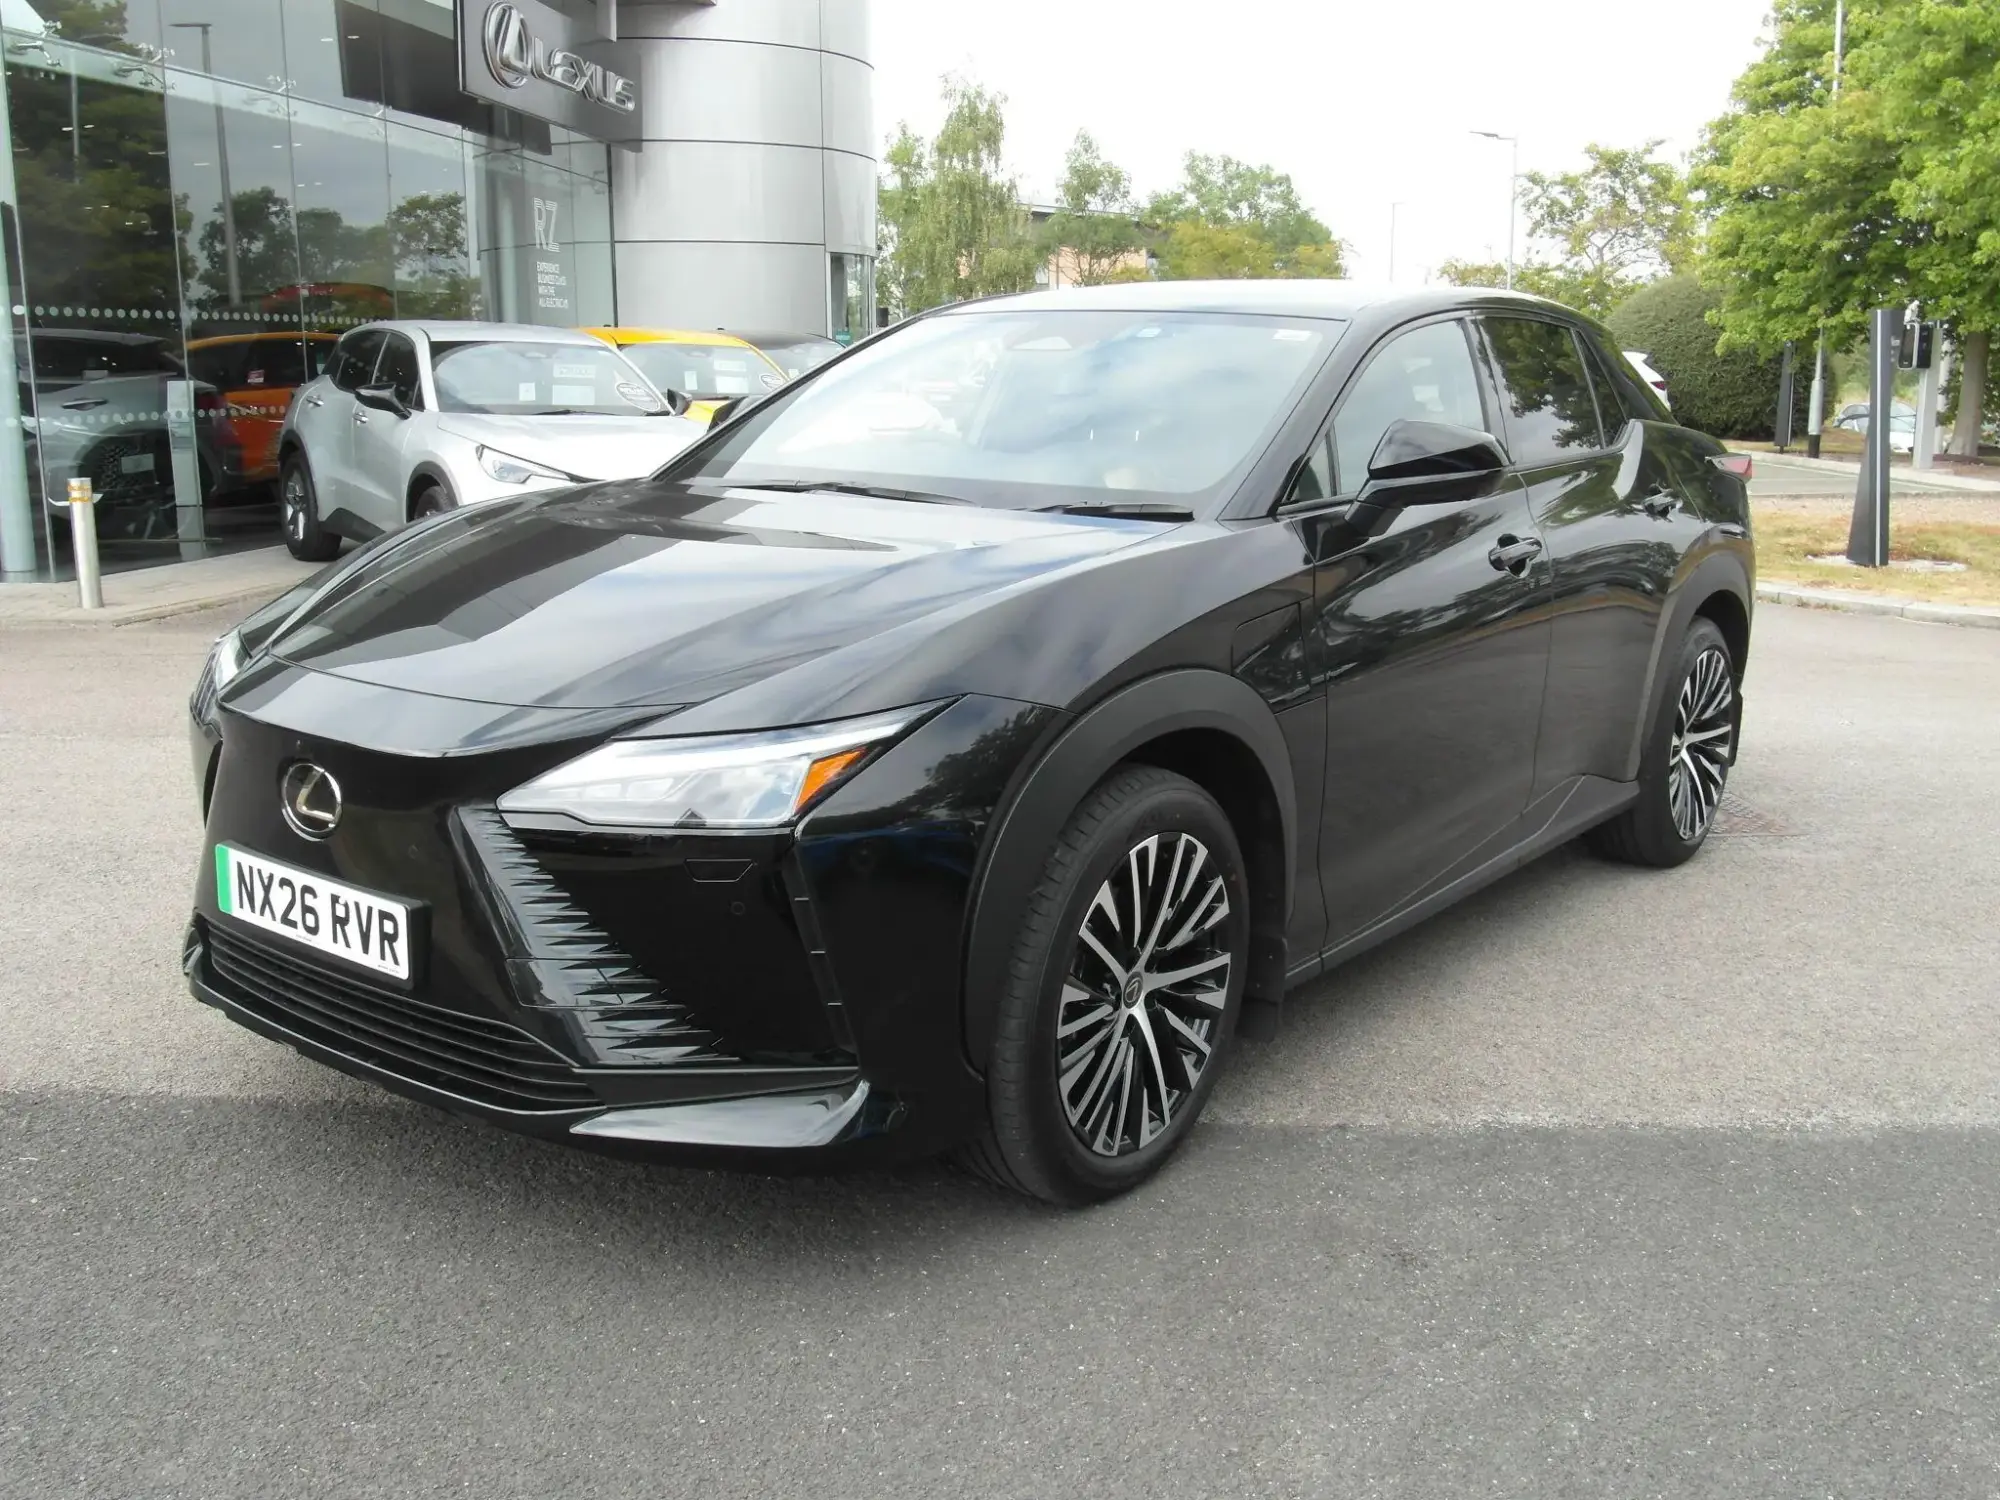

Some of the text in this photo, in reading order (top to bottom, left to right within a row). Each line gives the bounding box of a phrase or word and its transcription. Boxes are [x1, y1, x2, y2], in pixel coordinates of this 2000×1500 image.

[531, 36, 636, 114] LEXUS
[533, 197, 560, 253] RZ
[236, 861, 401, 967] NX26 RVR
